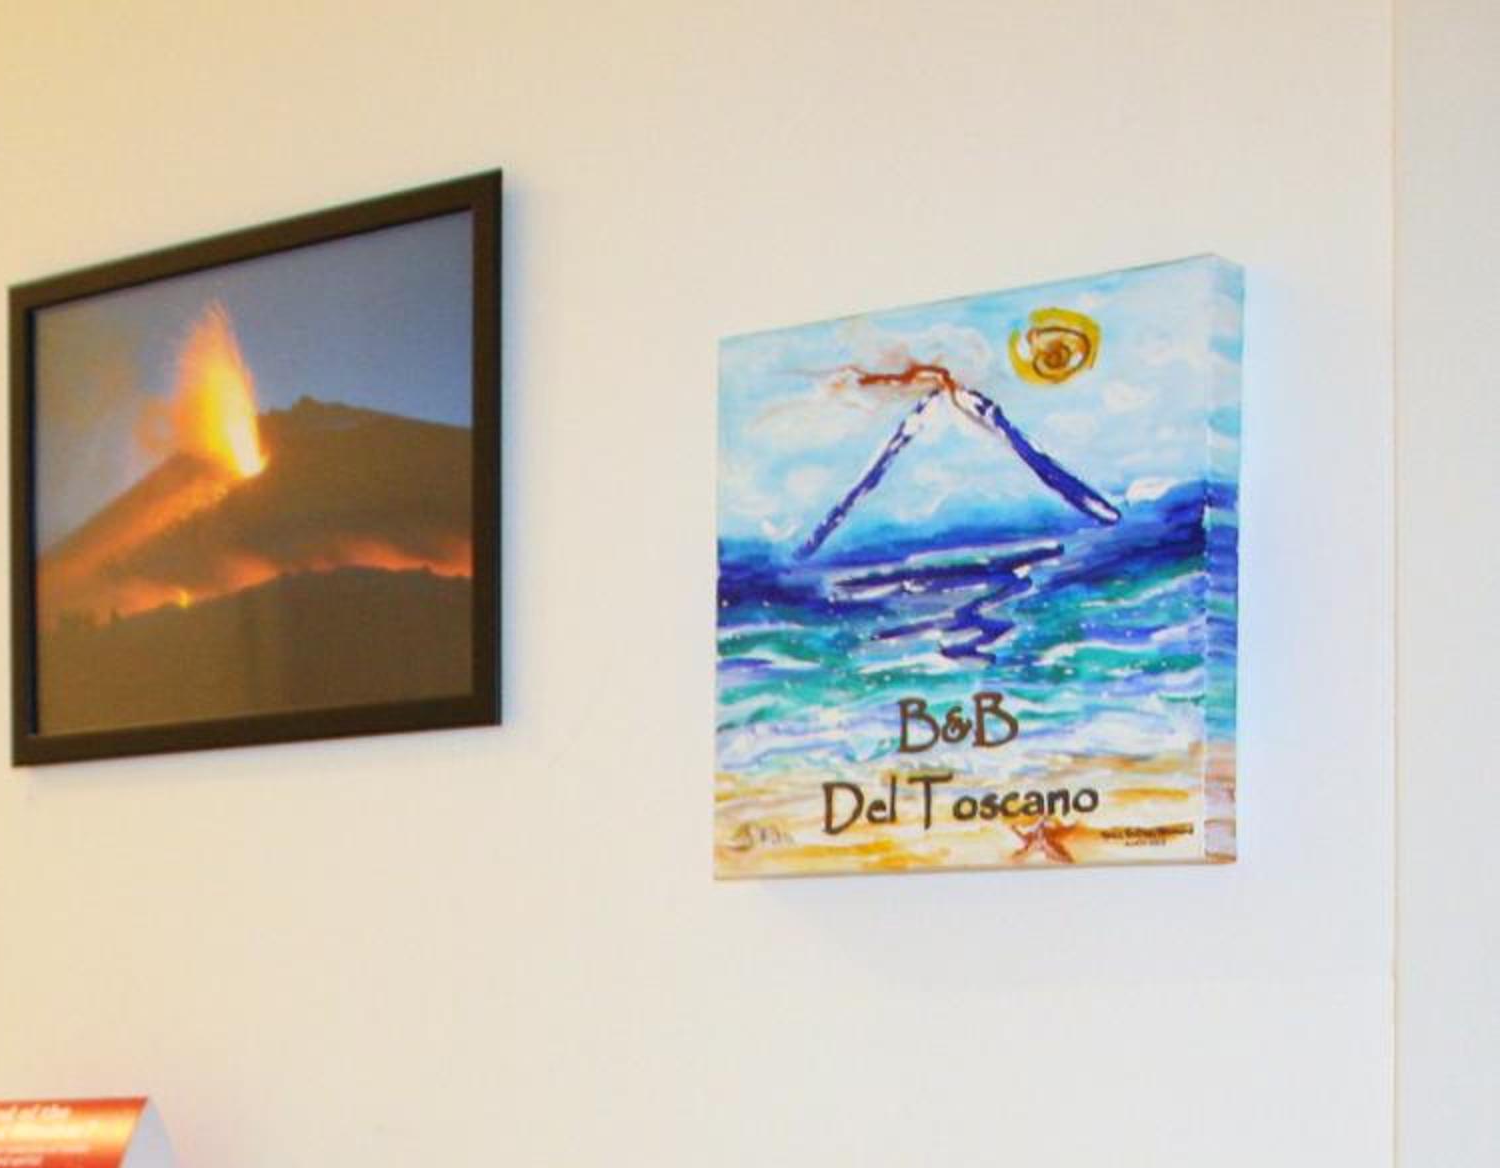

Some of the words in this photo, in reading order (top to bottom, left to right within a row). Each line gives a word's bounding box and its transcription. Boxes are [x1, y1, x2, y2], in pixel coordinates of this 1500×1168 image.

[898, 691, 1019, 754] B&B
[821, 774, 897, 835] Del
[906, 772, 1100, 831] Toscano
